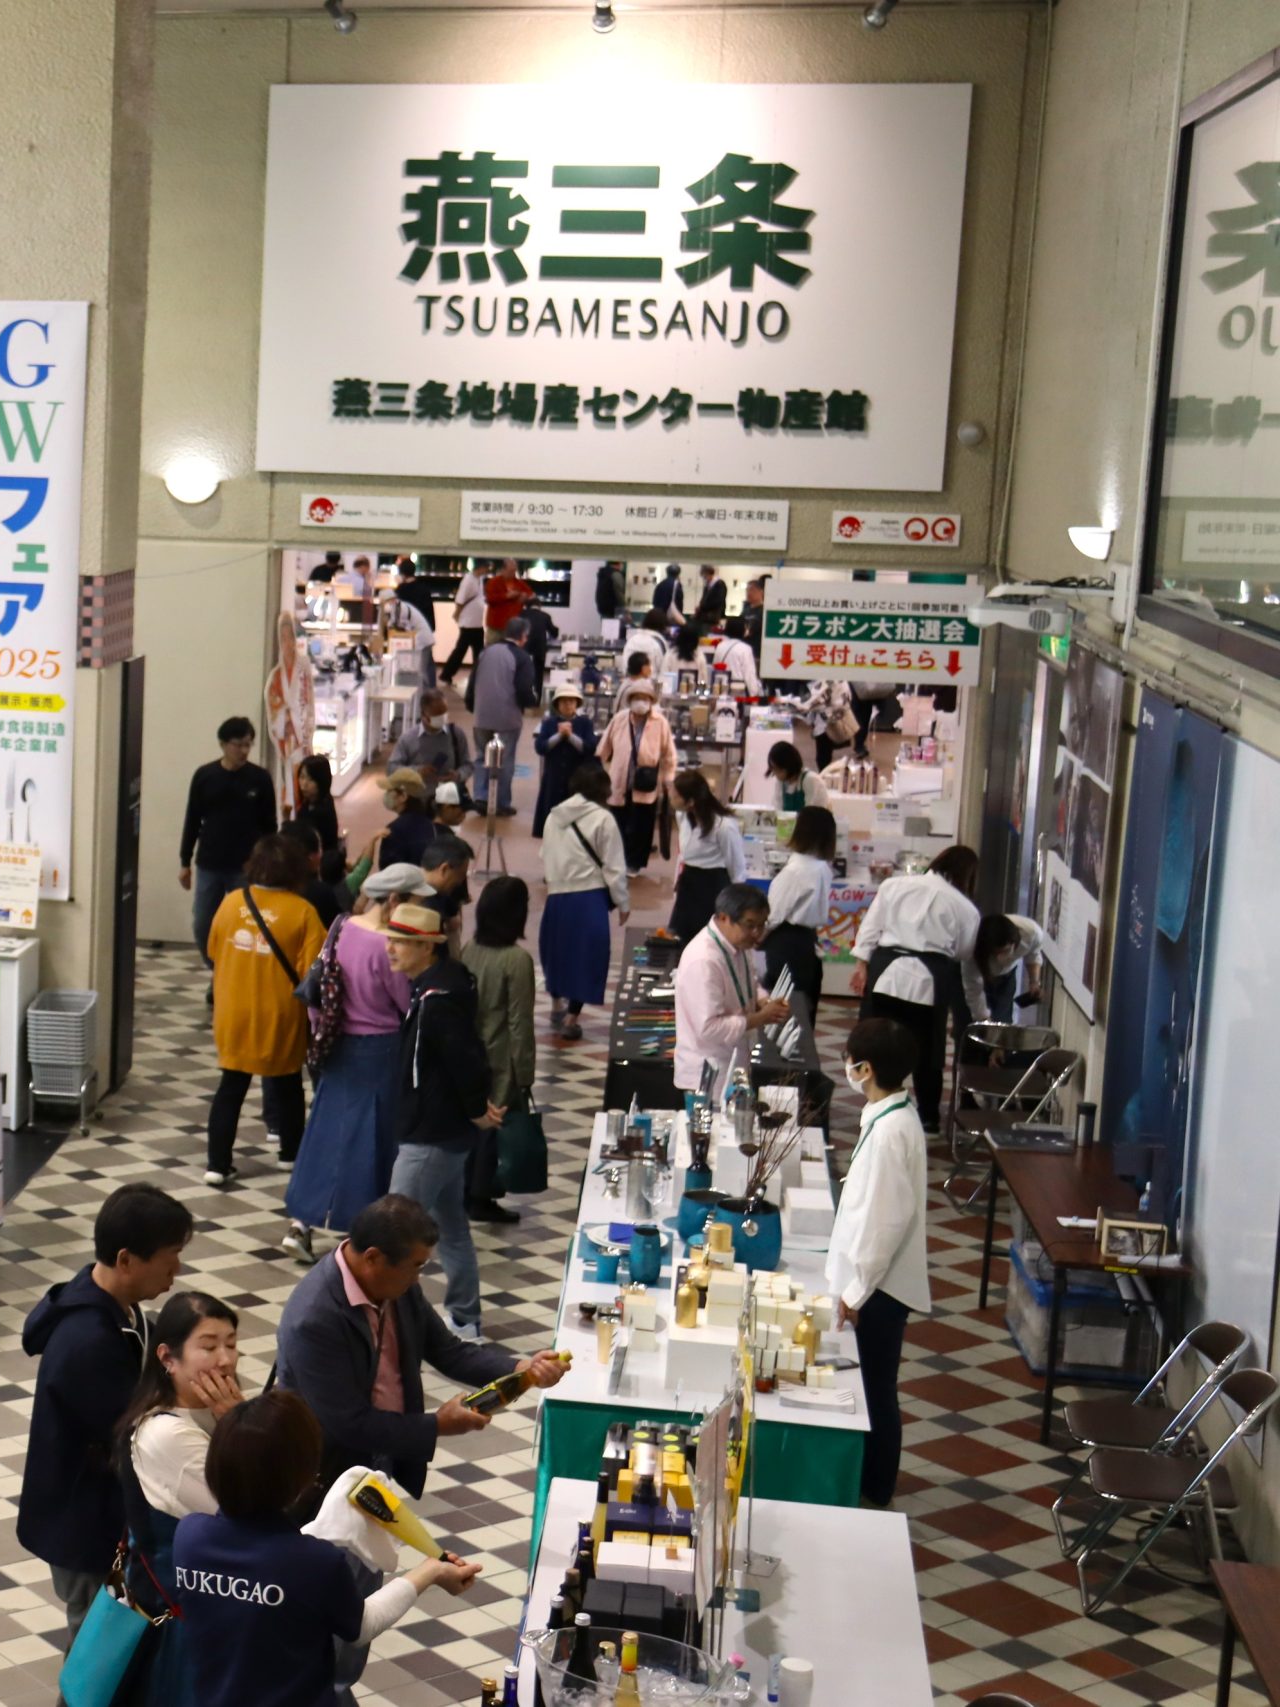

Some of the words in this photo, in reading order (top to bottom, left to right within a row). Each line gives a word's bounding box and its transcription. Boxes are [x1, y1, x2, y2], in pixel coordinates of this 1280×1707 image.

[401, 150, 815, 289] 燕三条
[416, 294, 790, 345] TSUBAMESANJO
[331, 378, 871, 433] 燕三条地場産センター物産館
[470, 502, 514, 514] 営業時間
[528, 504, 554, 515] 9:30
[573, 505, 603, 517] 17:30
[625, 507, 657, 519] 休館日
[778, 614, 966, 642] ガラポン大抽選会
[806, 644, 936, 670] 受付はこちら
[175, 1566, 285, 1606] FUKUGAO
